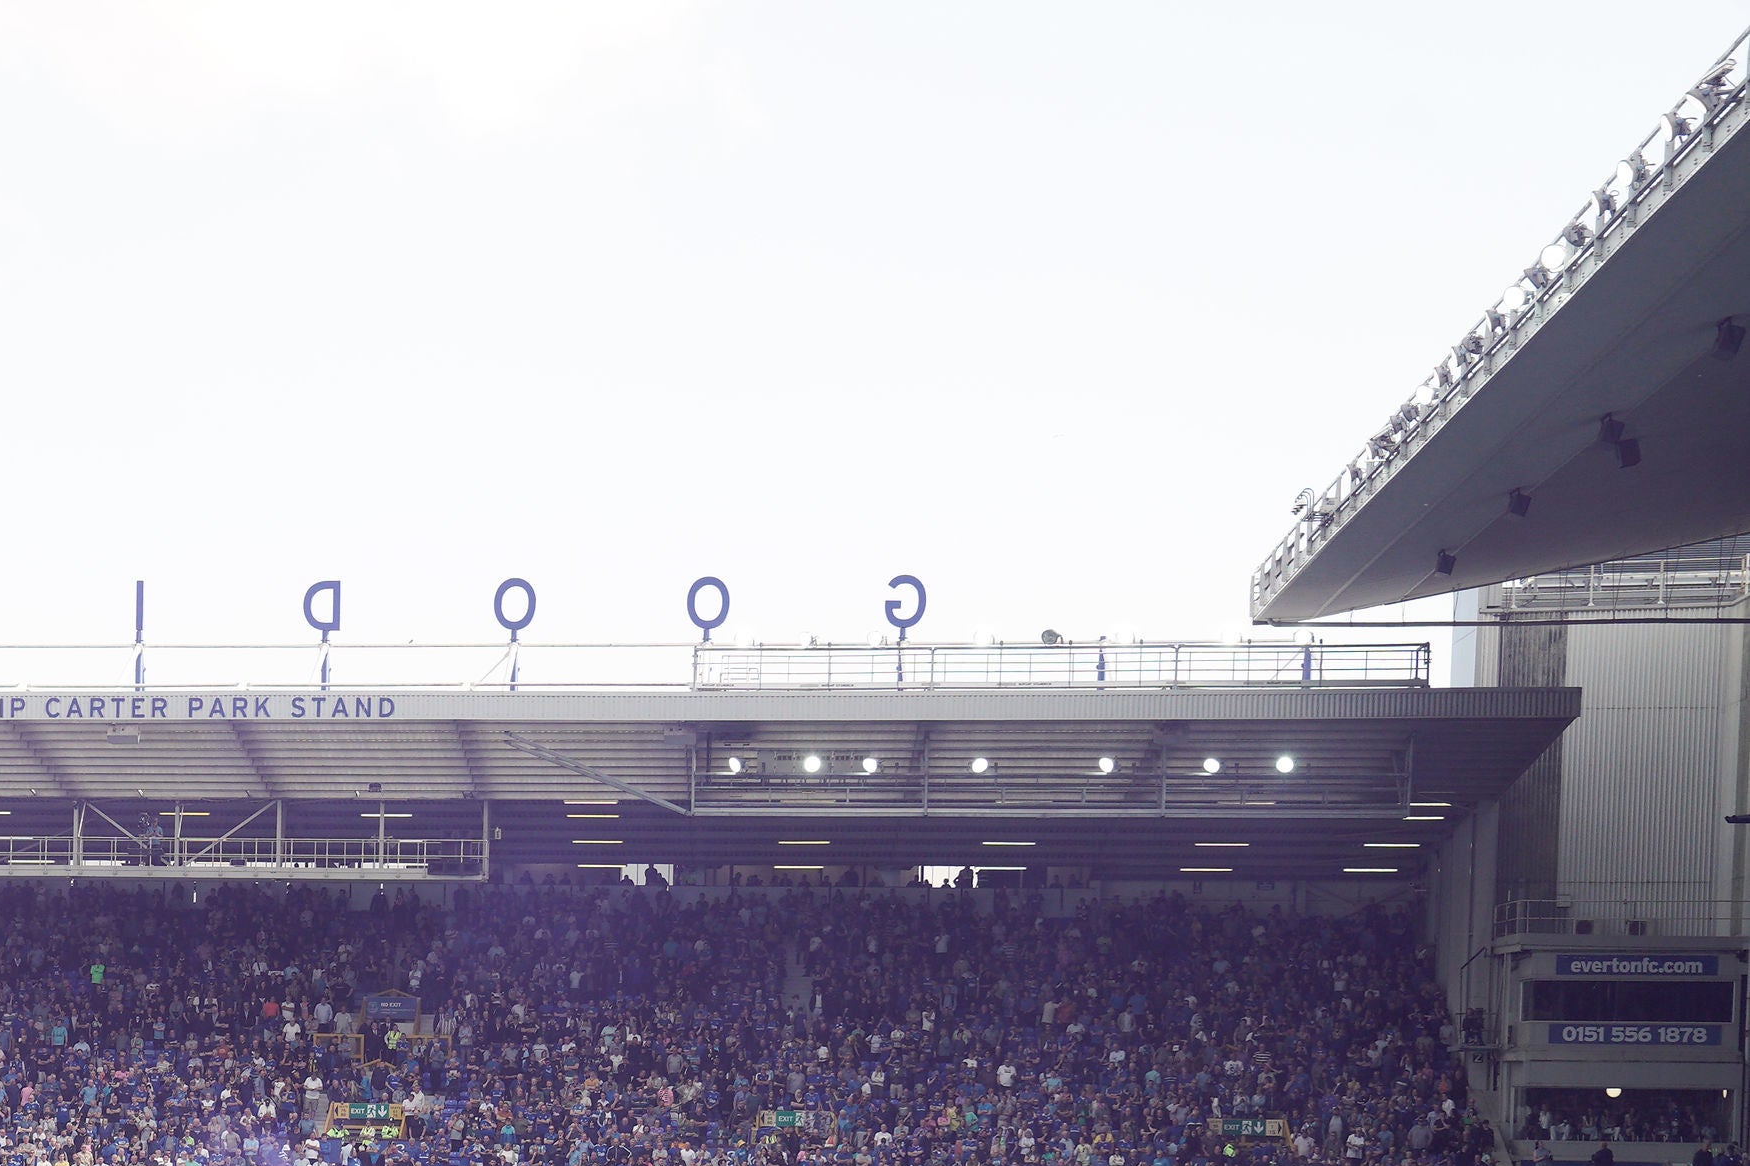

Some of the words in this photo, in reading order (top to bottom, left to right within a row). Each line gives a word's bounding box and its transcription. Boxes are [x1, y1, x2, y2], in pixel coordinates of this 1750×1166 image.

[45, 698, 167, 718] CARTER
[188, 697, 271, 718] PARK
[291, 697, 395, 718] STAND
[1570, 957, 1704, 975] evertonfc.com
[1562, 1026, 1606, 1043] 0151
[1610, 1026, 1653, 1043] 556
[1657, 1026, 1708, 1043] 1878
